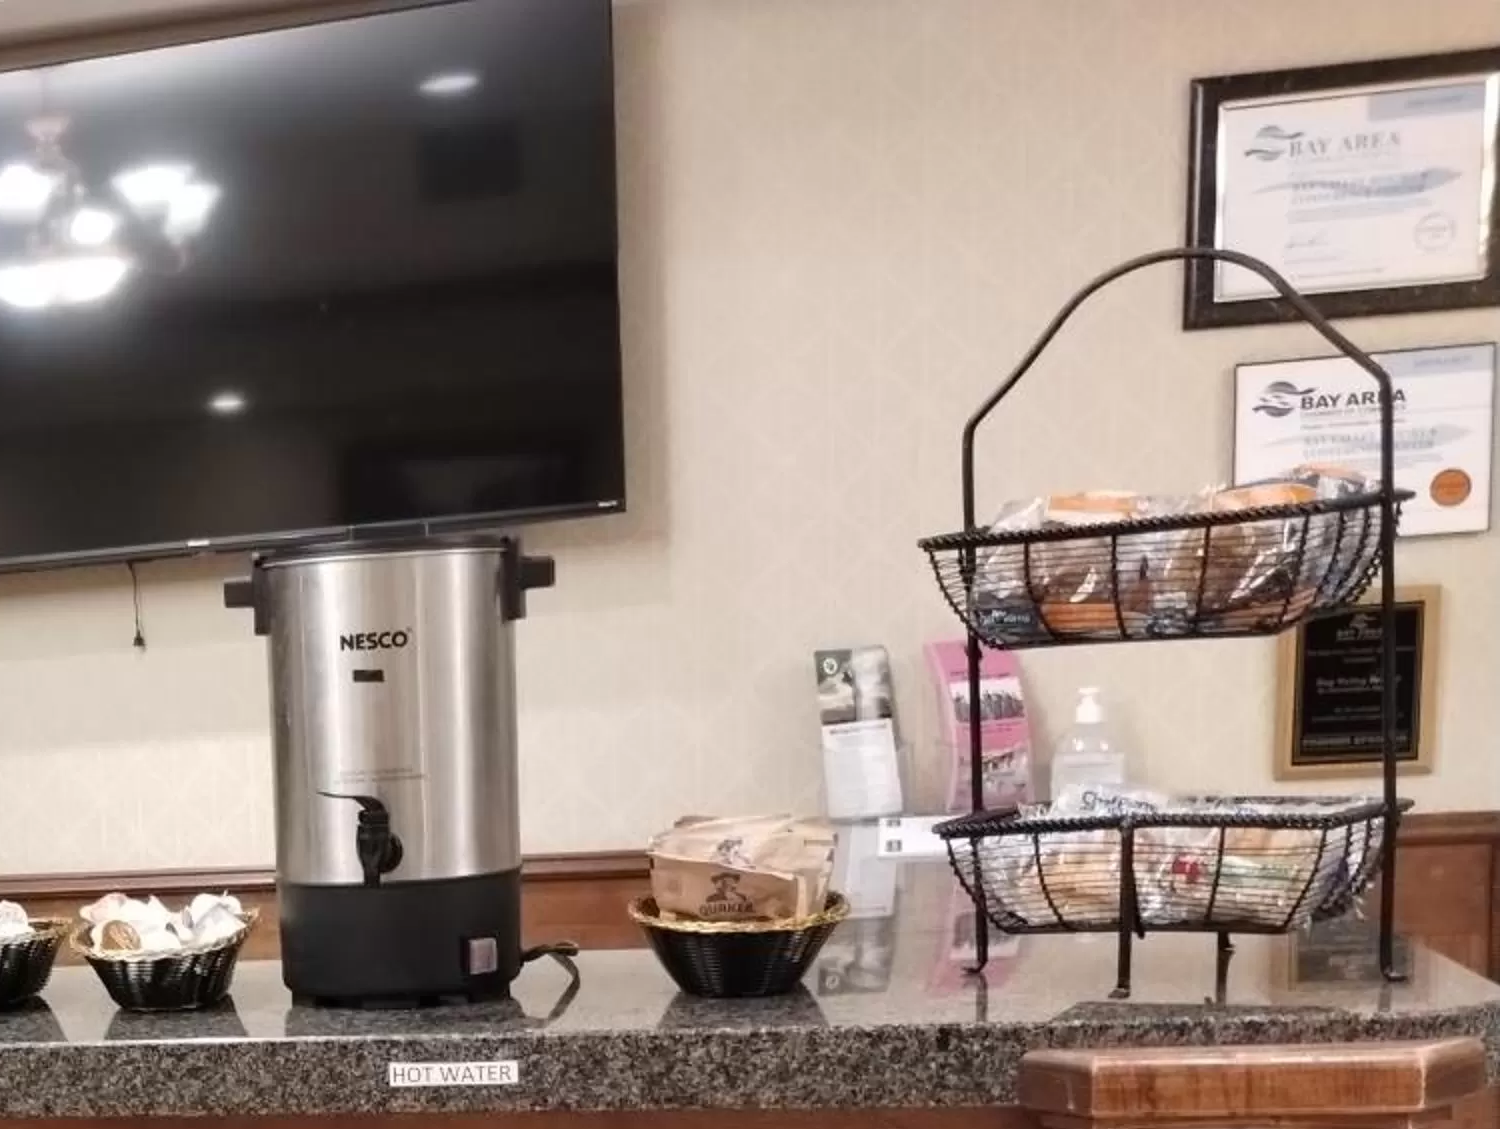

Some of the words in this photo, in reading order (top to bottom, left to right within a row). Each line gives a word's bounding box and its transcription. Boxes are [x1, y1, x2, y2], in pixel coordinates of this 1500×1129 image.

[1289, 137, 1332, 157] BAY
[1339, 131, 1400, 151] AREA
[1301, 393, 1342, 410] BAY
[1346, 388, 1407, 406] ARA
[340, 630, 408, 651] NESCO
[393, 1066, 432, 1083] HOT
[440, 1064, 511, 1082] WATER
